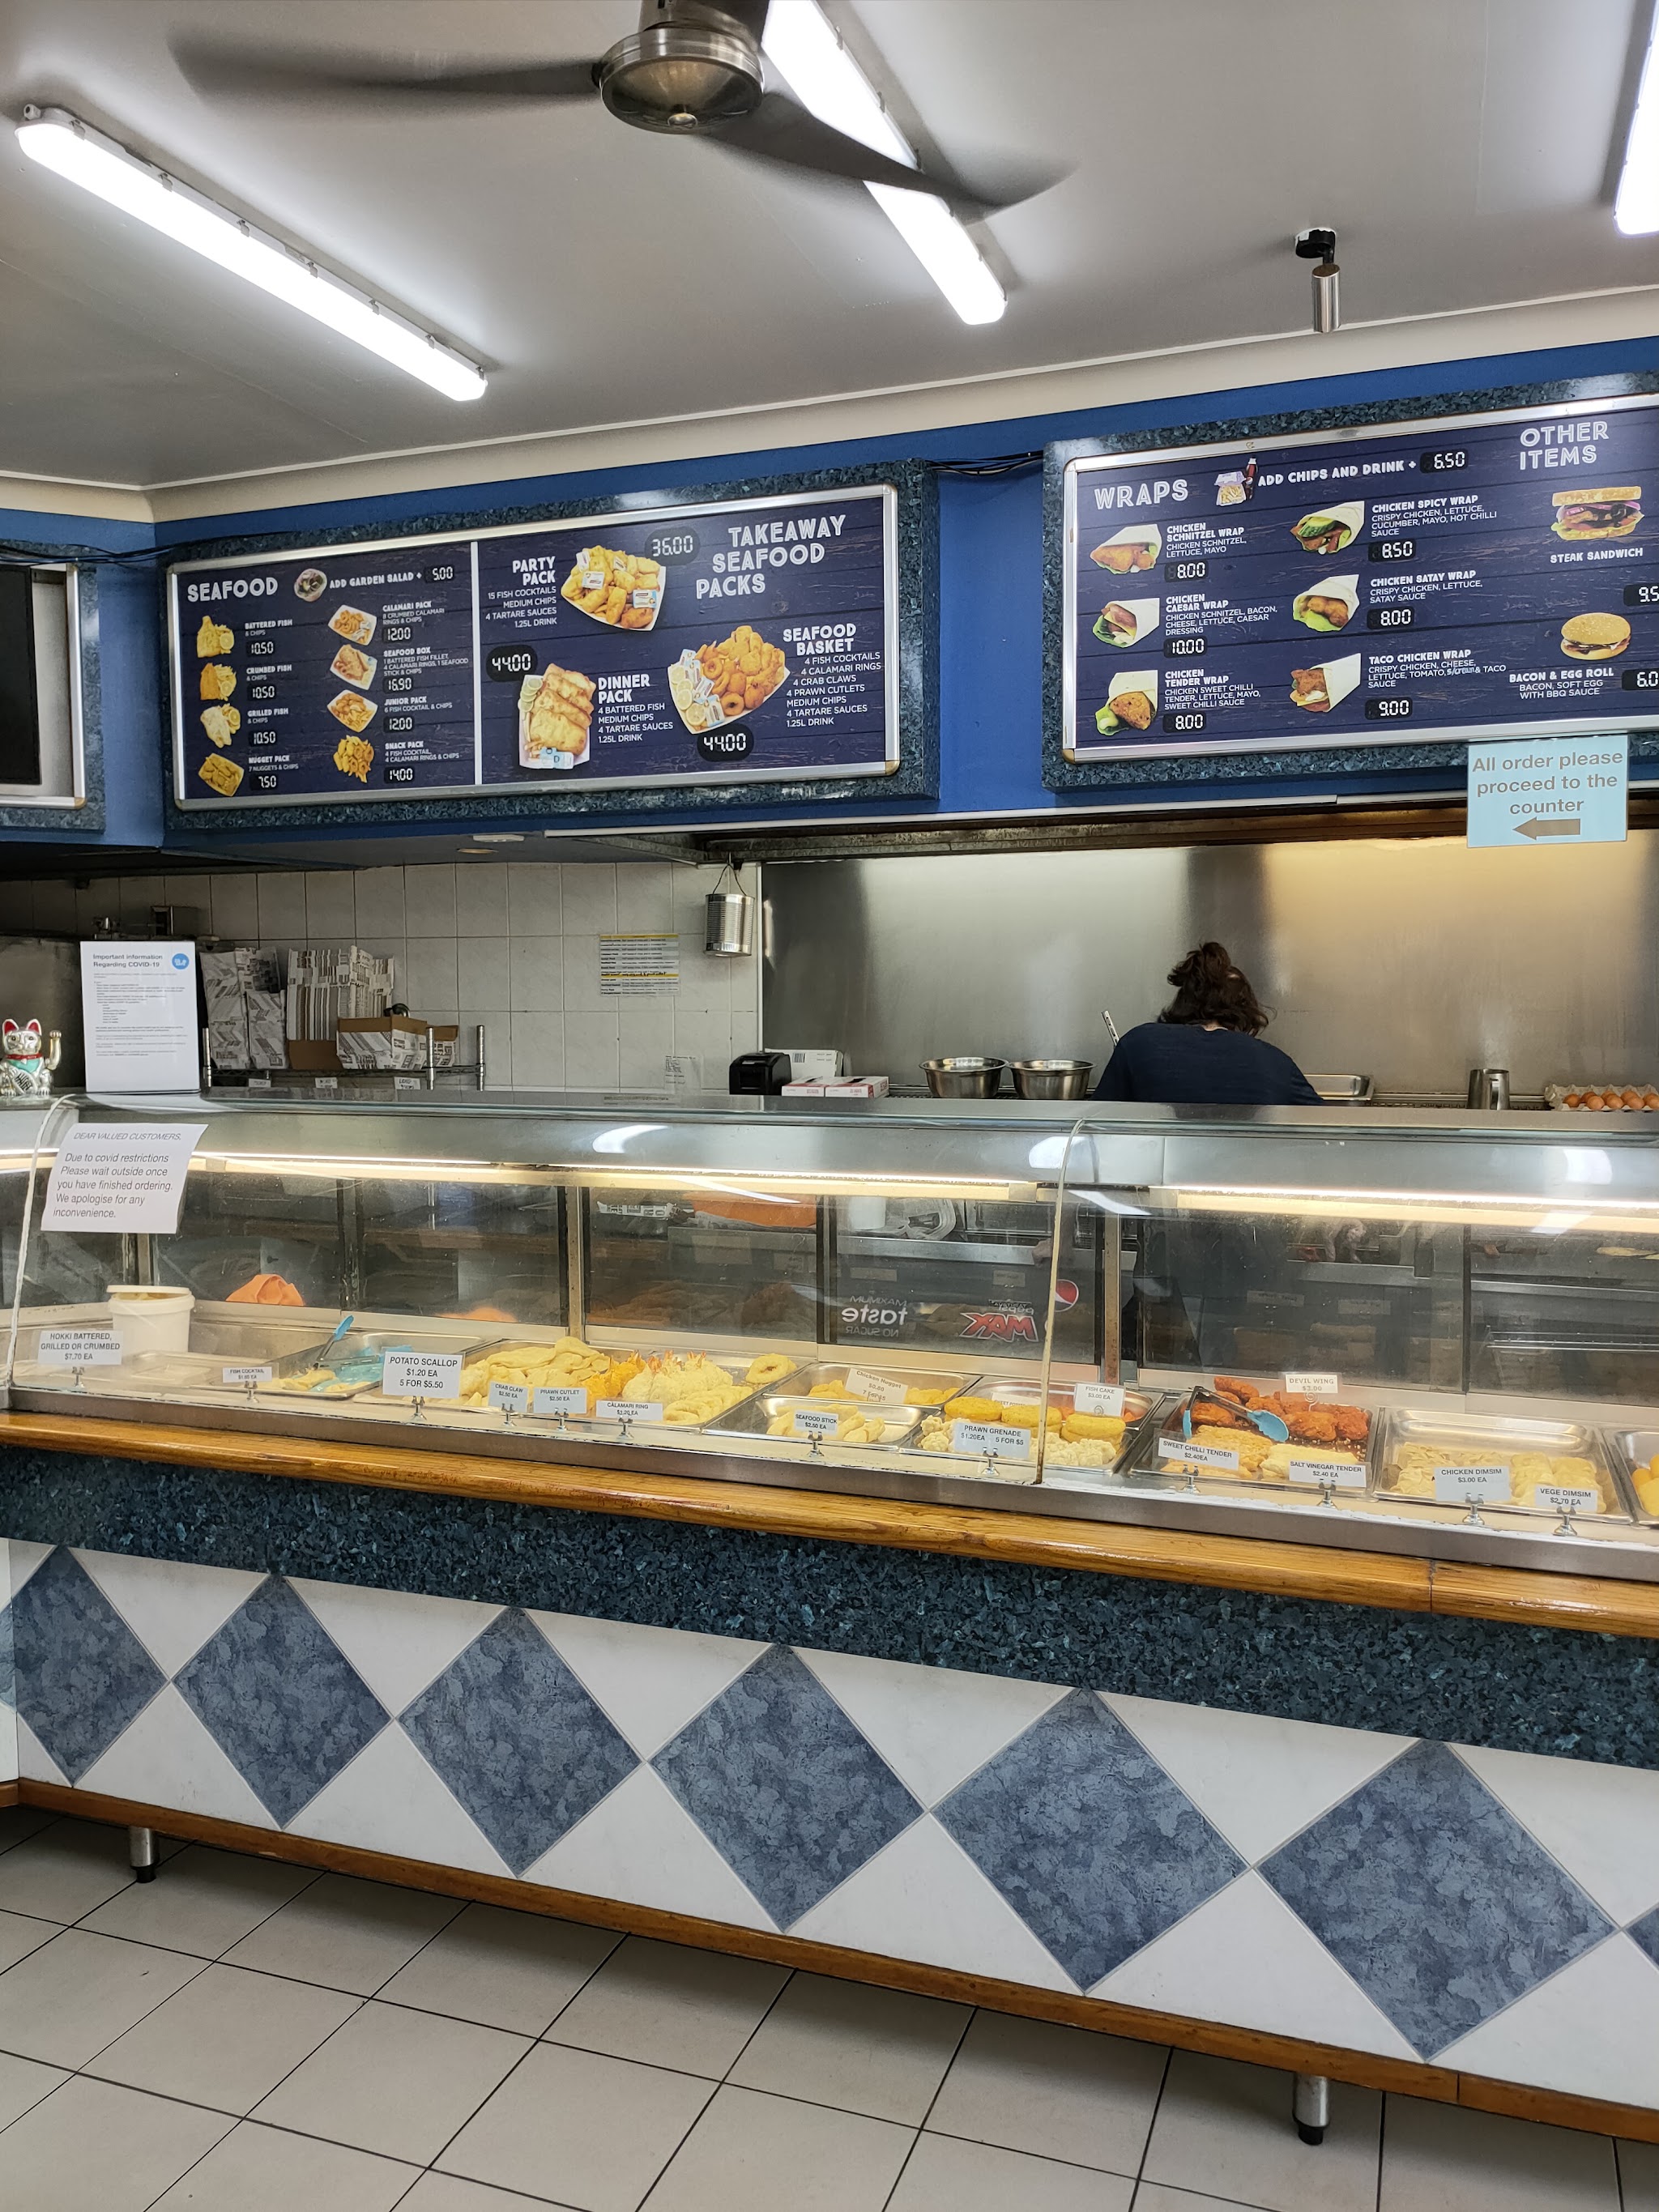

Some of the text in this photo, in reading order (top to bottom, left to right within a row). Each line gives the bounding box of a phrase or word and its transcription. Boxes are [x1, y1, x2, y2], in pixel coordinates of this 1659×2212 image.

[1520, 421, 1609, 446] OTHER
[1434, 451, 1464, 468] 6.50
[1520, 445, 1596, 469] ITEMS
[1258, 474, 1283, 486] ADD
[1288, 469, 1328, 482] CHIPS
[1332, 466, 1358, 478] AND
[1363, 460, 1404, 475] DRINK
[1094, 479, 1188, 509] WRAPS
[1372, 495, 1478, 513] CHICKEN SPICY WRAP
[728, 514, 845, 547] TAKEAWAY
[1166, 527, 1243, 542] SCHNITZEL WRAP
[653, 535, 693, 556] 36.00
[1166, 537, 1246, 551] CHICKEN SCHNITZEL,
[1382, 541, 1412, 558] 8.50
[712, 543, 824, 573] SEAFOOD
[1550, 548, 1643, 563] STEAK SANDWICH
[513, 556, 555, 574] PARTY
[1177, 562, 1205, 578] 8.00
[330, 578, 346, 588] ADD
[349, 575, 384, 586] GARDEN
[387, 572, 413, 582] SALAD
[433, 566, 452, 580] 5.00
[522, 569, 555, 585] PACK
[1371, 570, 1475, 586] CHICKEN SATAY WRAP
[188, 577, 277, 602] SEAFOOD
[696, 573, 765, 599] PACKS
[382, 600, 431, 612] CALAMARI PACK
[503, 596, 556, 607] MEDIUM CHIPS
[1166, 600, 1228, 612] CAESAR WRAP
[245, 620, 275, 629] BATTERED
[534, 617, 557, 625] DRINK
[1380, 609, 1410, 625] 8.00
[783, 623, 855, 641] SEAFOOD
[251, 641, 273, 654] 10.50
[383, 648, 414, 657] SEAFOOD
[796, 637, 853, 655] BASKET
[1172, 638, 1204, 654] 10.00
[492, 654, 530, 671] 44.00
[1369, 650, 1470, 664] TACO CHICKEN WRAP
[1165, 676, 1228, 687] TENDER WRAP
[1509, 667, 1614, 682] BACON & EGG ROLL
[598, 674, 650, 692] DINNER
[794, 687, 825, 696] PRAWN
[827, 684, 864, 693] CUTLETS
[384, 697, 408, 705] JUNIOR
[599, 687, 632, 703] PACK
[1520, 688, 1599, 699] WITH BBQ SAUCE
[794, 707, 831, 716] TARTARE
[834, 705, 867, 714] SAUCES
[1165, 698, 1244, 710] SWEET CHILLI SAUCE
[1379, 700, 1409, 715] 9.00
[704, 733, 745, 751] 44.00
[1473, 752, 1623, 772] All order please
[1478, 774, 1617, 797] proceed to the
[1509, 799, 1584, 815] counter
[65, 1153, 168, 1162] Due to covid restrictions
[61, 1166, 89, 1174] Please
[92, 1167, 109, 1175] wait
[112, 1167, 143, 1175] outside
[58, 1180, 173, 1192] you have finished ordering.
[57, 1193, 145, 1206] We apologise for any
[53, 1207, 116, 1217] inconvenience.
[390, 1357, 457, 1366] POTATO SCALLOP
[407, 1368, 425, 1376] $1.20
[424, 1380, 443, 1388] $5.50
[989, 1428, 1021, 1437] GRENADE
[1163, 1441, 1232, 1458] SWEET CHILLI TENDER
